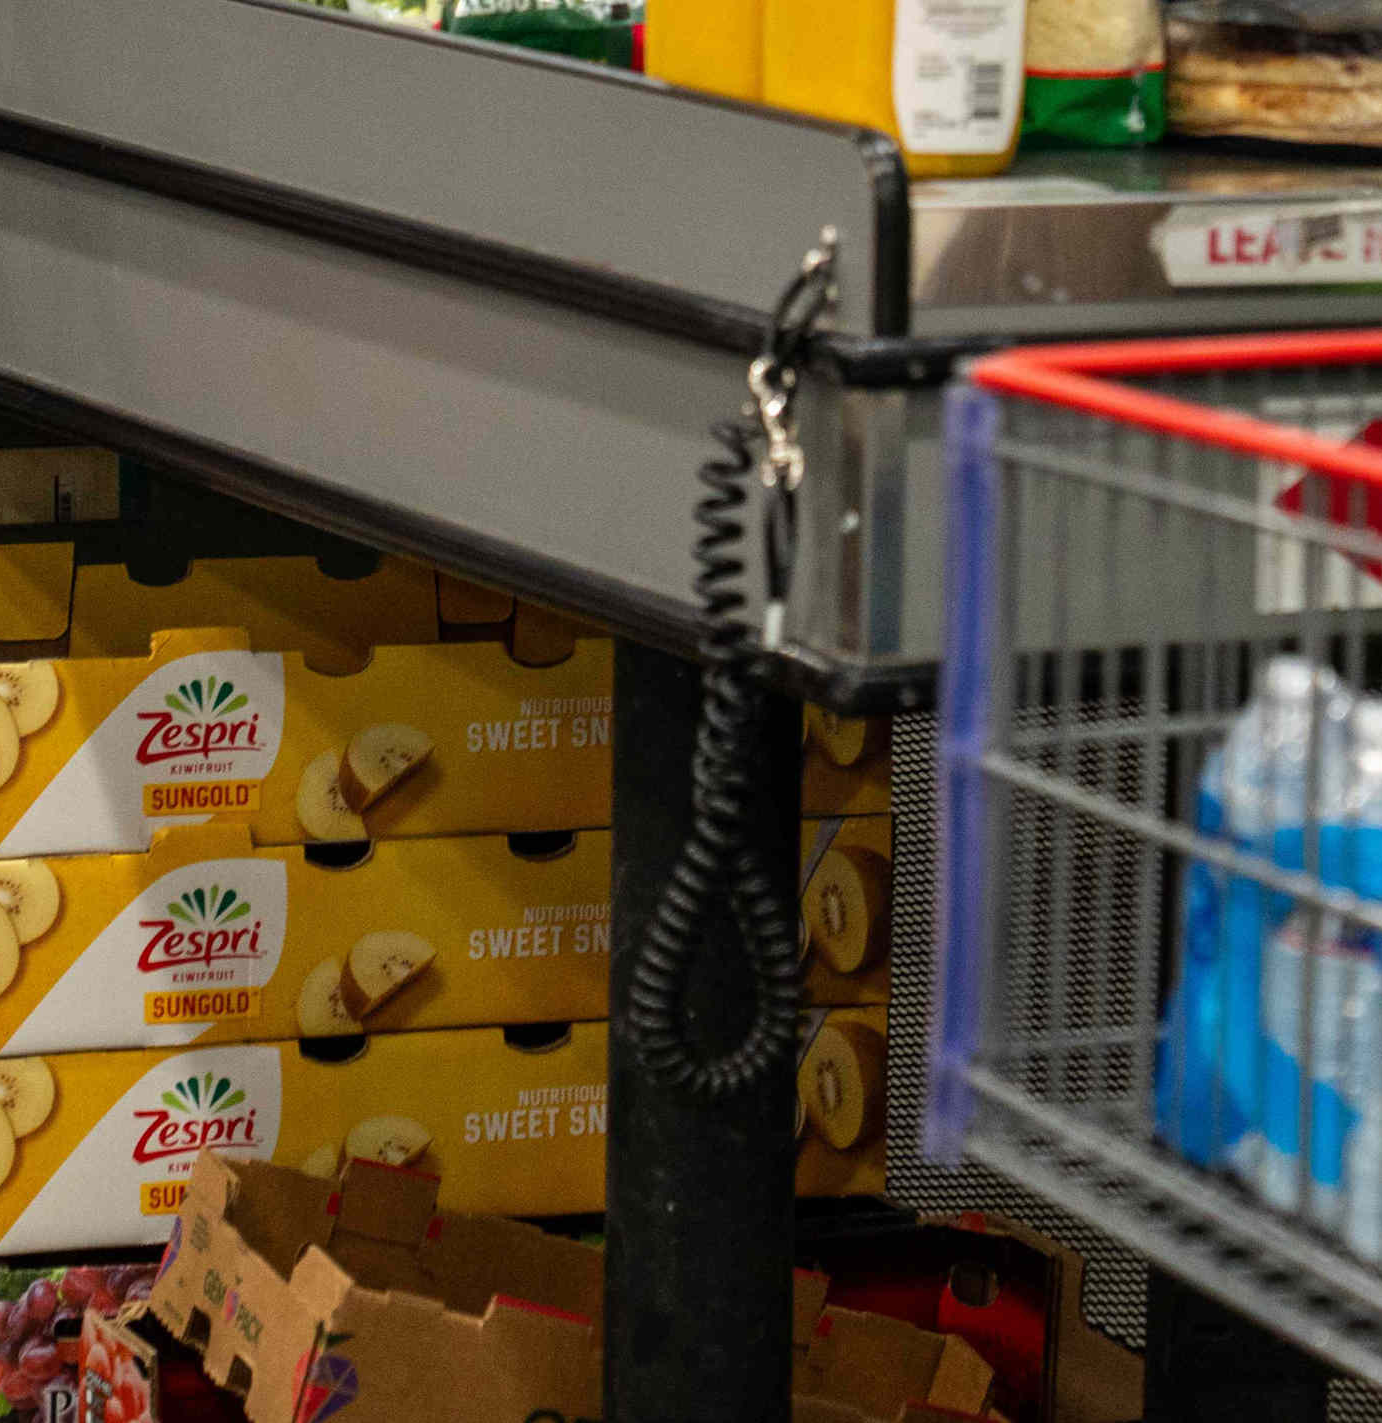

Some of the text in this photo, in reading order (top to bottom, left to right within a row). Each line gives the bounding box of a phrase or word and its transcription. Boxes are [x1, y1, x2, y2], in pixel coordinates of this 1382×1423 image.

[521, 696, 613, 717] NUTRITIOUS
[136, 711, 260, 764] Zespri
[466, 721, 560, 754] SWEET
[170, 760, 234, 776] KIWIFRUIT
[151, 783, 251, 811] SUNGOLD
[138, 920, 262, 973] Zespri
[469, 927, 562, 960] SWEET
[172, 970, 235, 984] KIWIFRUIT
[152, 990, 251, 1017] SUNGOLD
[132, 1109, 257, 1164] Zespri
[464, 1111, 558, 1144] SWEET
